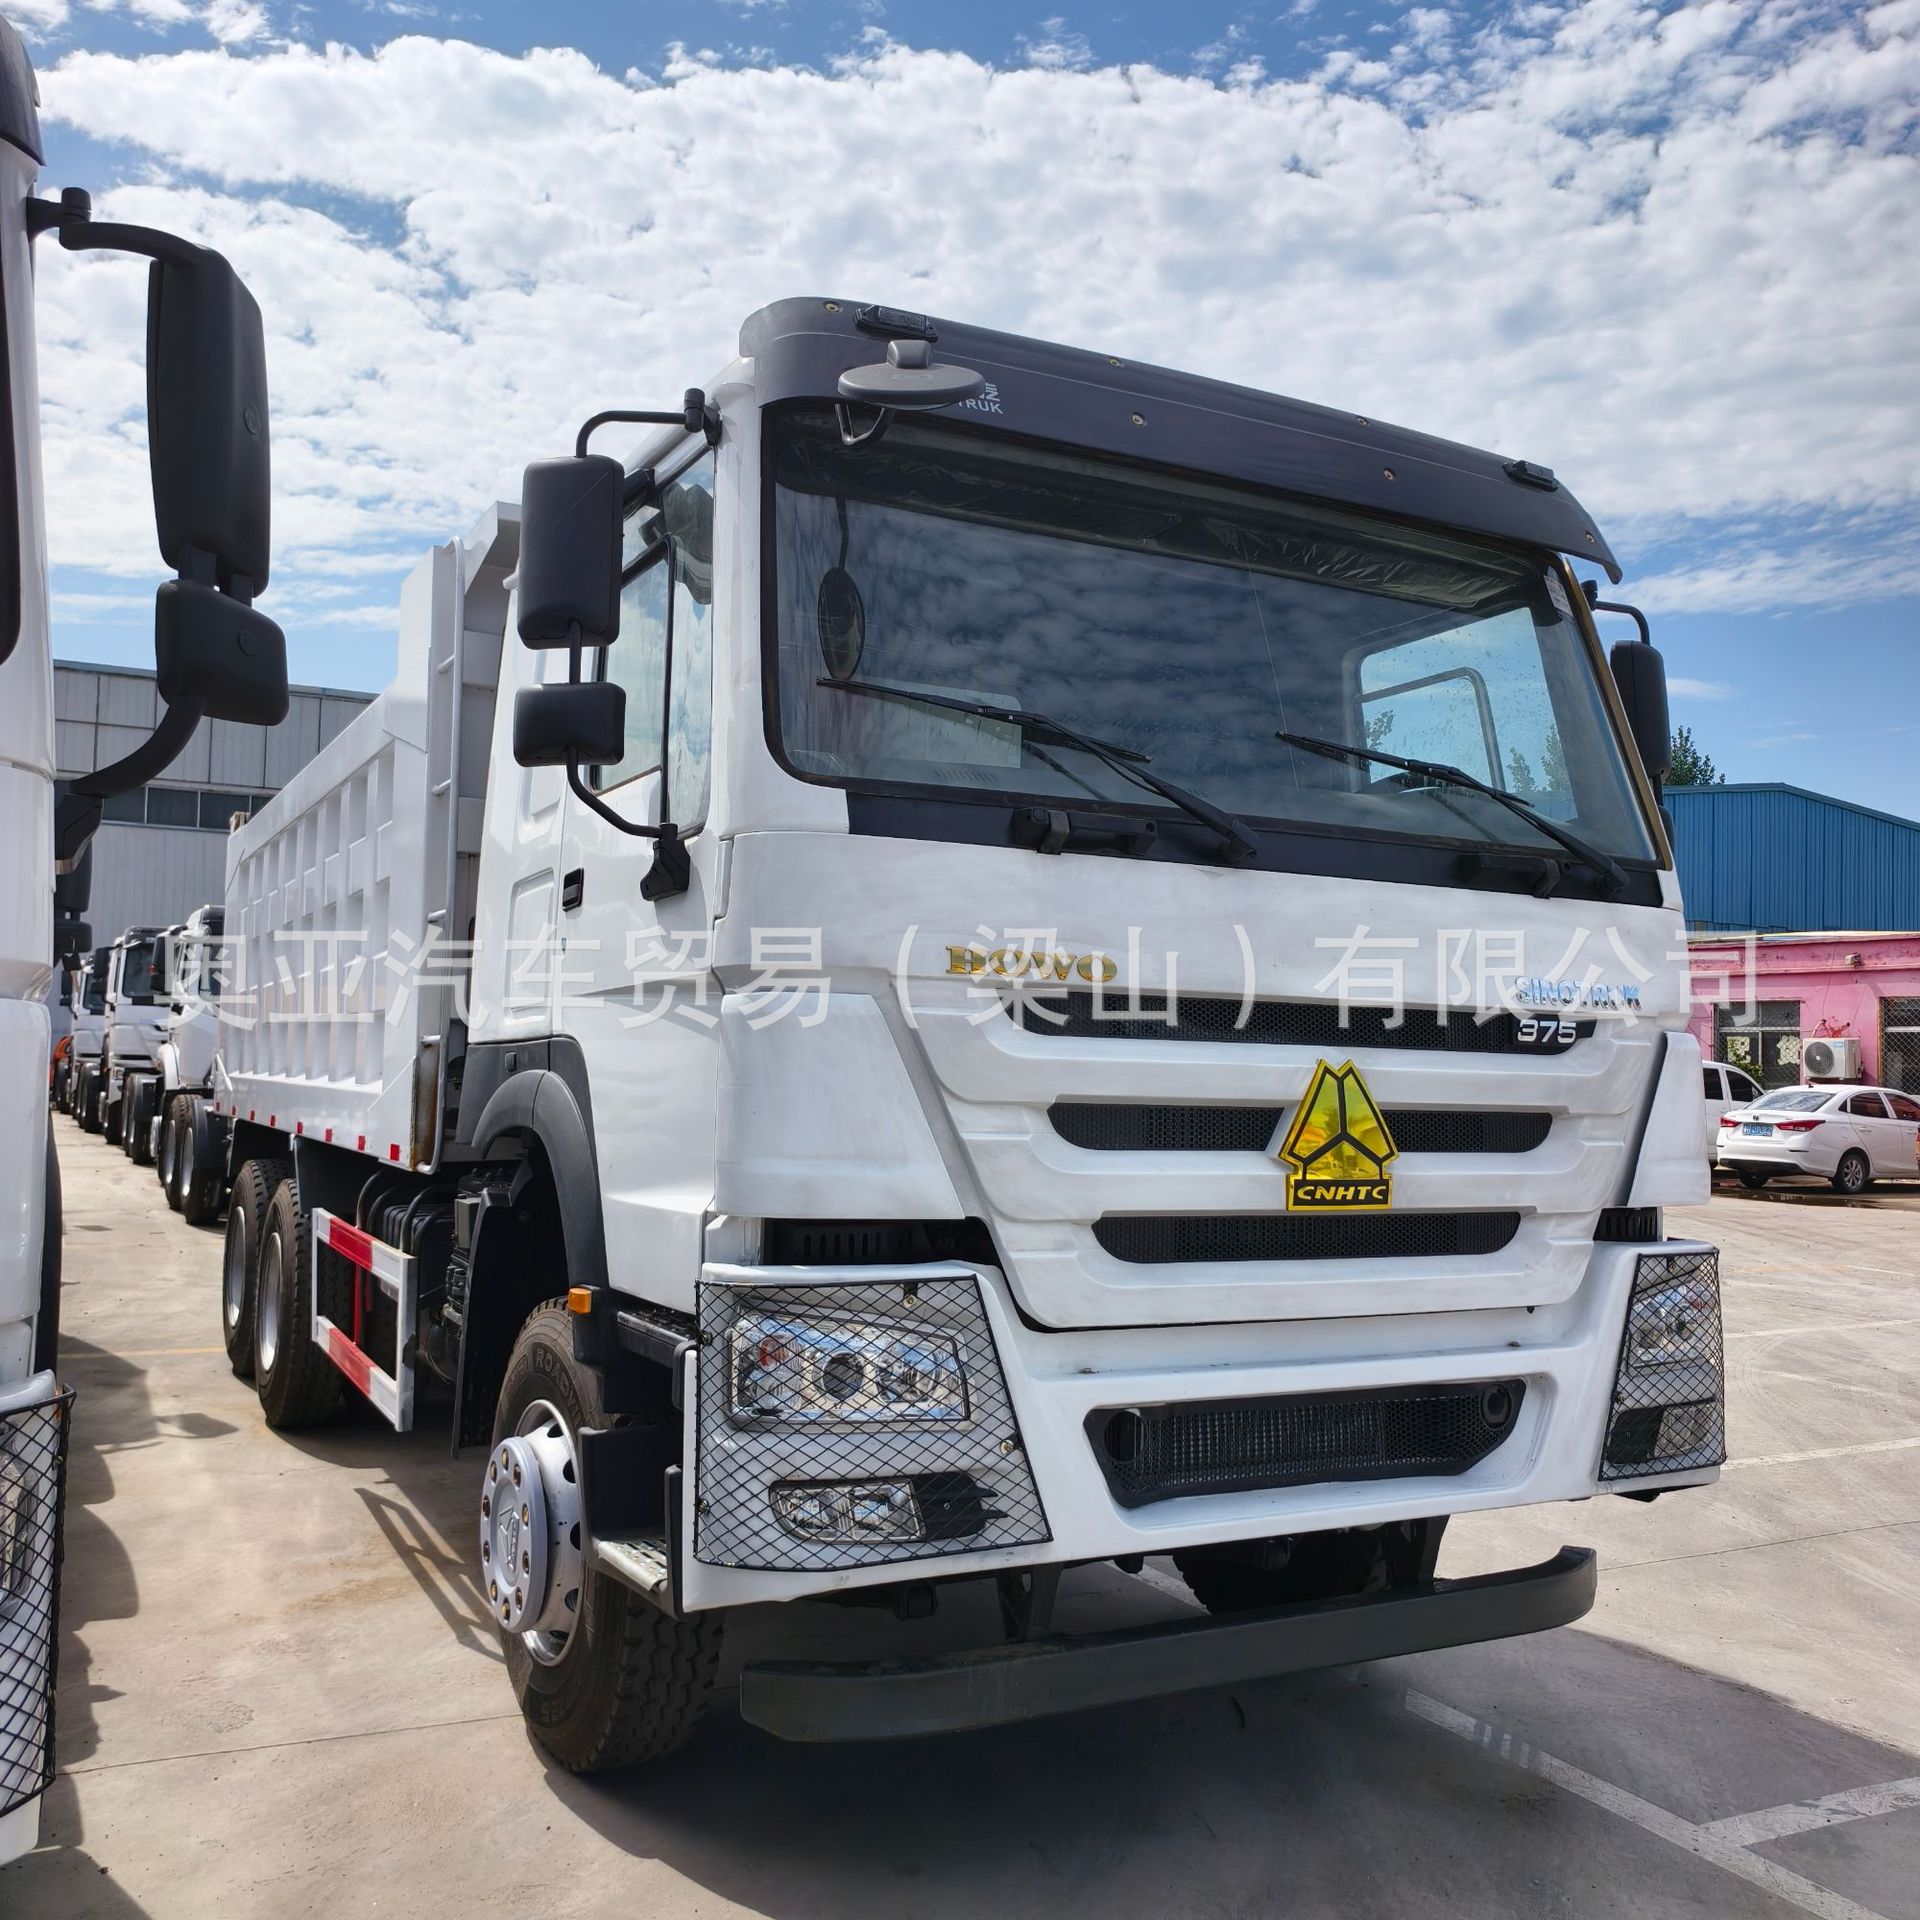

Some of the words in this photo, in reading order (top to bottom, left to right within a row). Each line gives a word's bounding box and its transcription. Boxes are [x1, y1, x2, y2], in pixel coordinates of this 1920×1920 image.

[945, 945, 1118, 982] HOWO
[1517, 1018, 1577, 1044] 375
[1297, 1186, 1386, 1200] CNHTC
